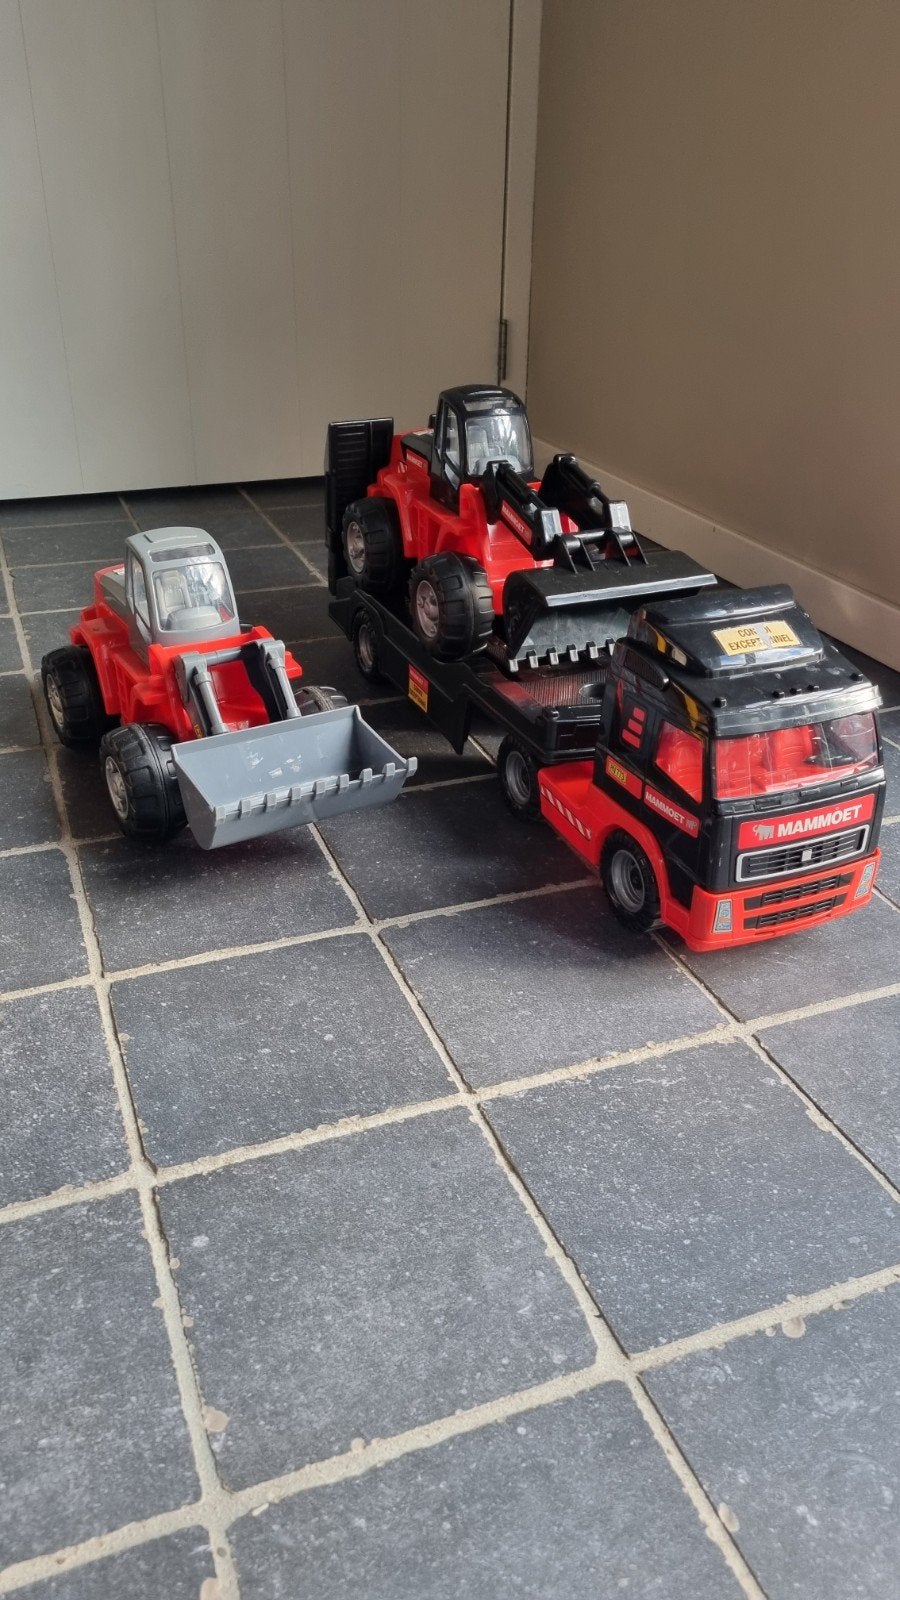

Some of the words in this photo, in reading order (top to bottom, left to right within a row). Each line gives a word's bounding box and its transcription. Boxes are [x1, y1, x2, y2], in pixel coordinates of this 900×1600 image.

[738, 625, 772, 638] CONI
[645, 791, 685, 824] MAMMOET
[777, 804, 863, 838] MAMMOET
